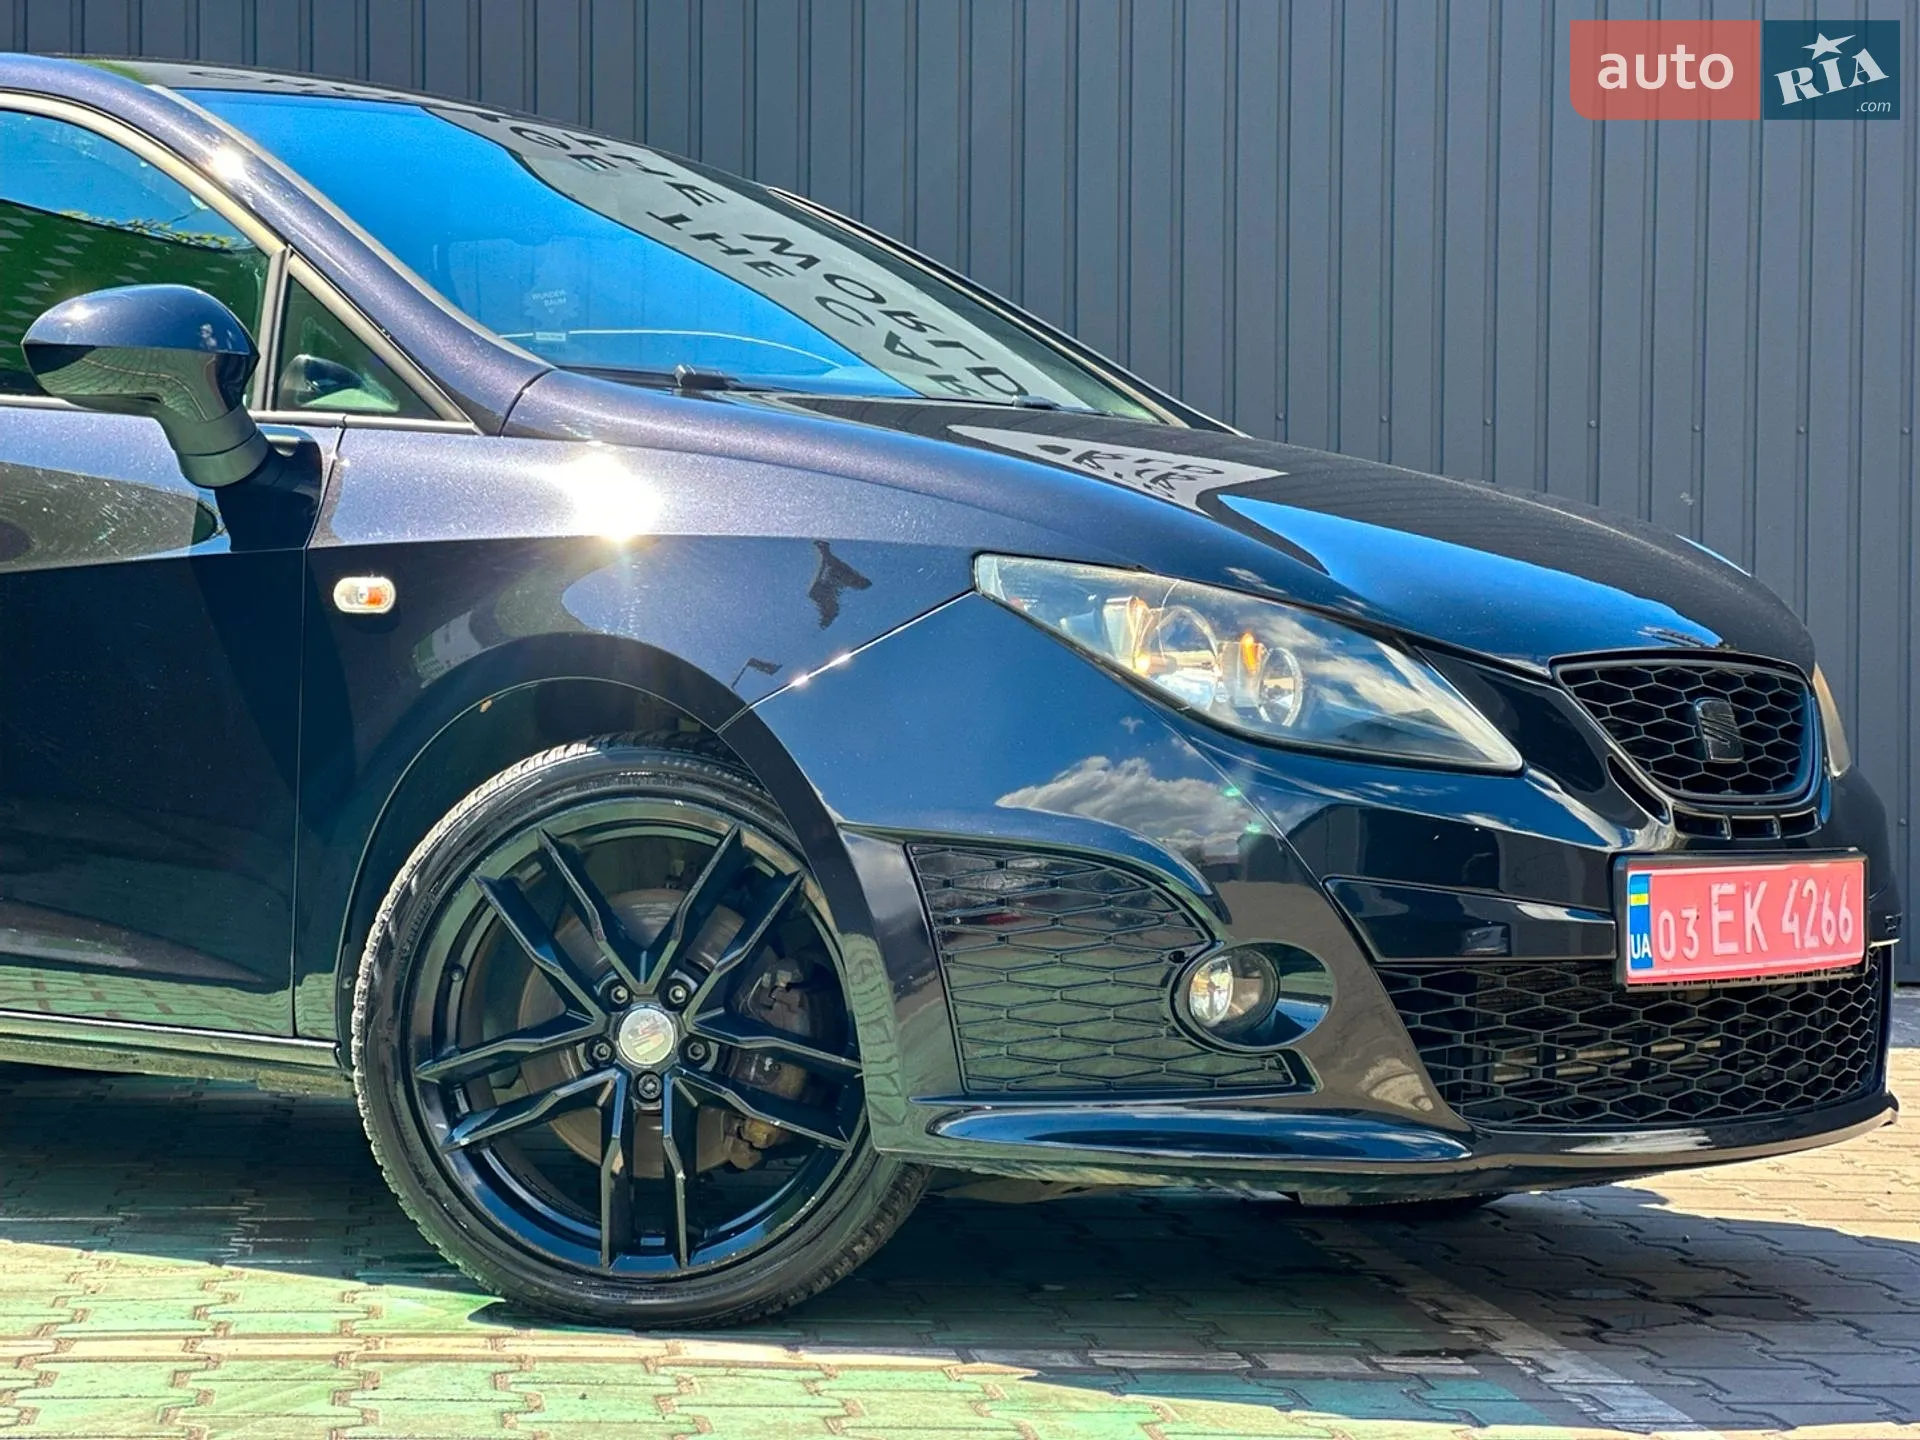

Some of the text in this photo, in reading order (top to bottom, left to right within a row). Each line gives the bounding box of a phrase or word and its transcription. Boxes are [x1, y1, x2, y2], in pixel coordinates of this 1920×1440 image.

[1657, 874, 1854, 961] 03 EK 4266
[1630, 933, 1652, 959] UA
